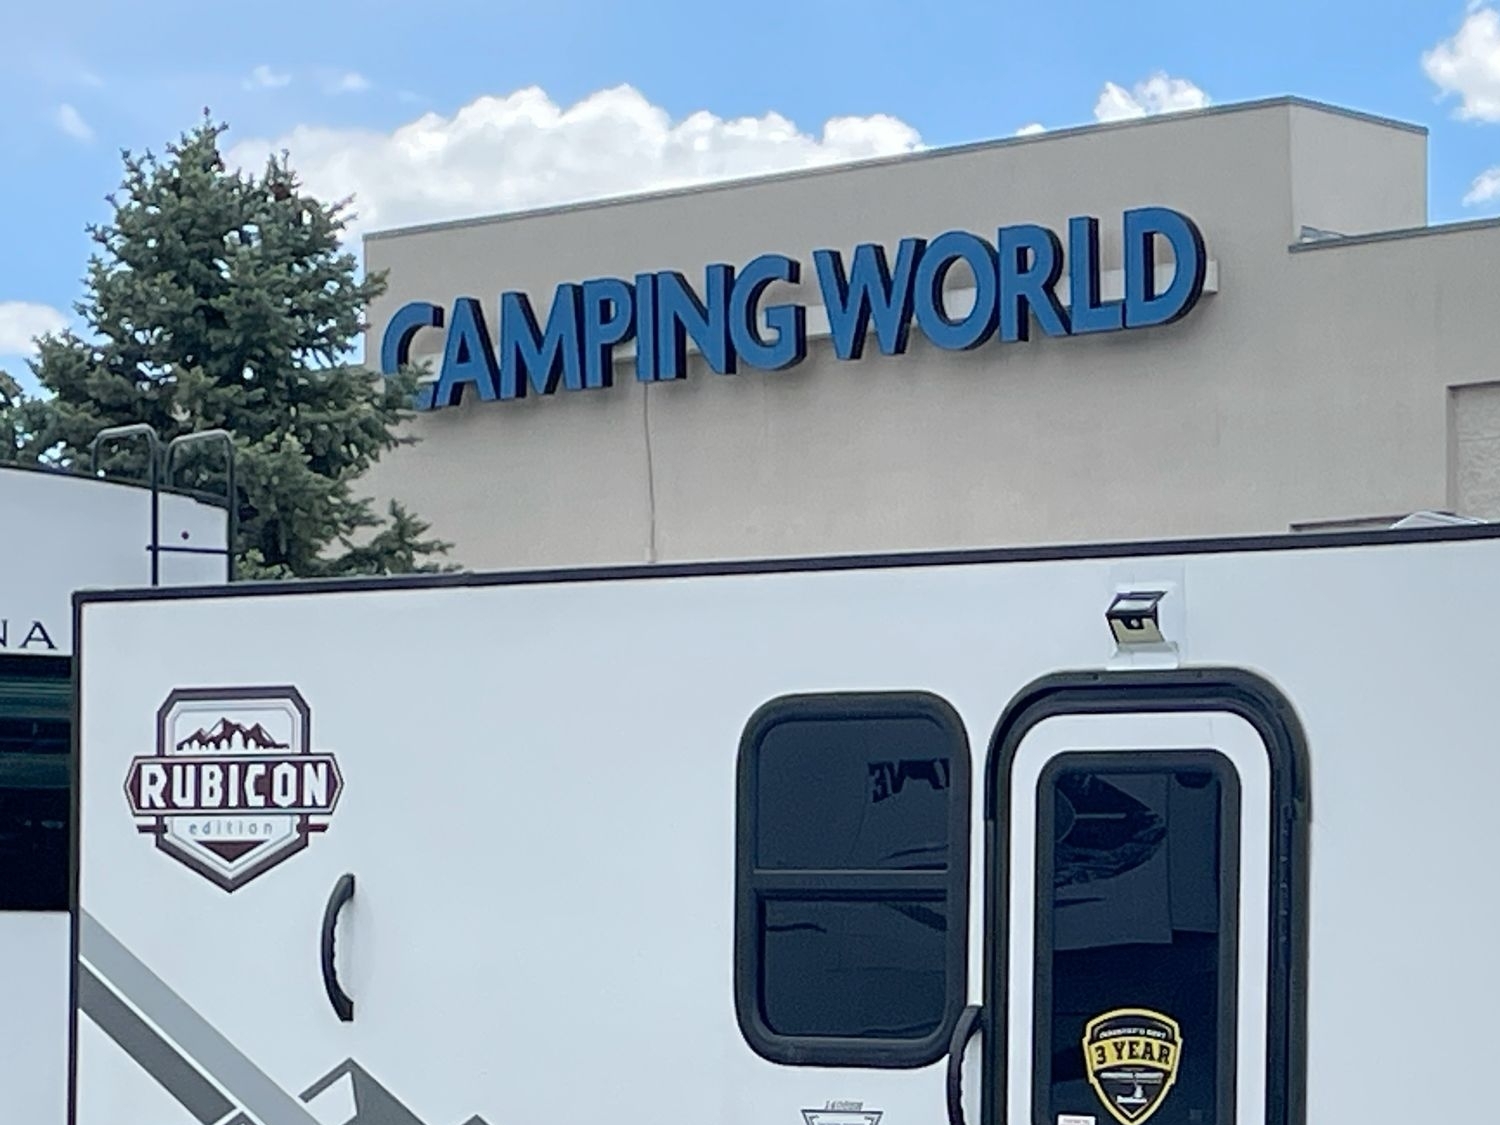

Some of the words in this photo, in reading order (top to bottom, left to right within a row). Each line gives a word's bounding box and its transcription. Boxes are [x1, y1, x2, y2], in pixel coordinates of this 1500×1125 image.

[383, 254, 804, 410] CAMPING
[813, 206, 1208, 360] WORLD
[139, 762, 328, 808] RUBICON
[188, 819, 274, 836] edition
[1095, 1045, 1107, 1065] 3
[1111, 1040, 1170, 1066] YEAR
